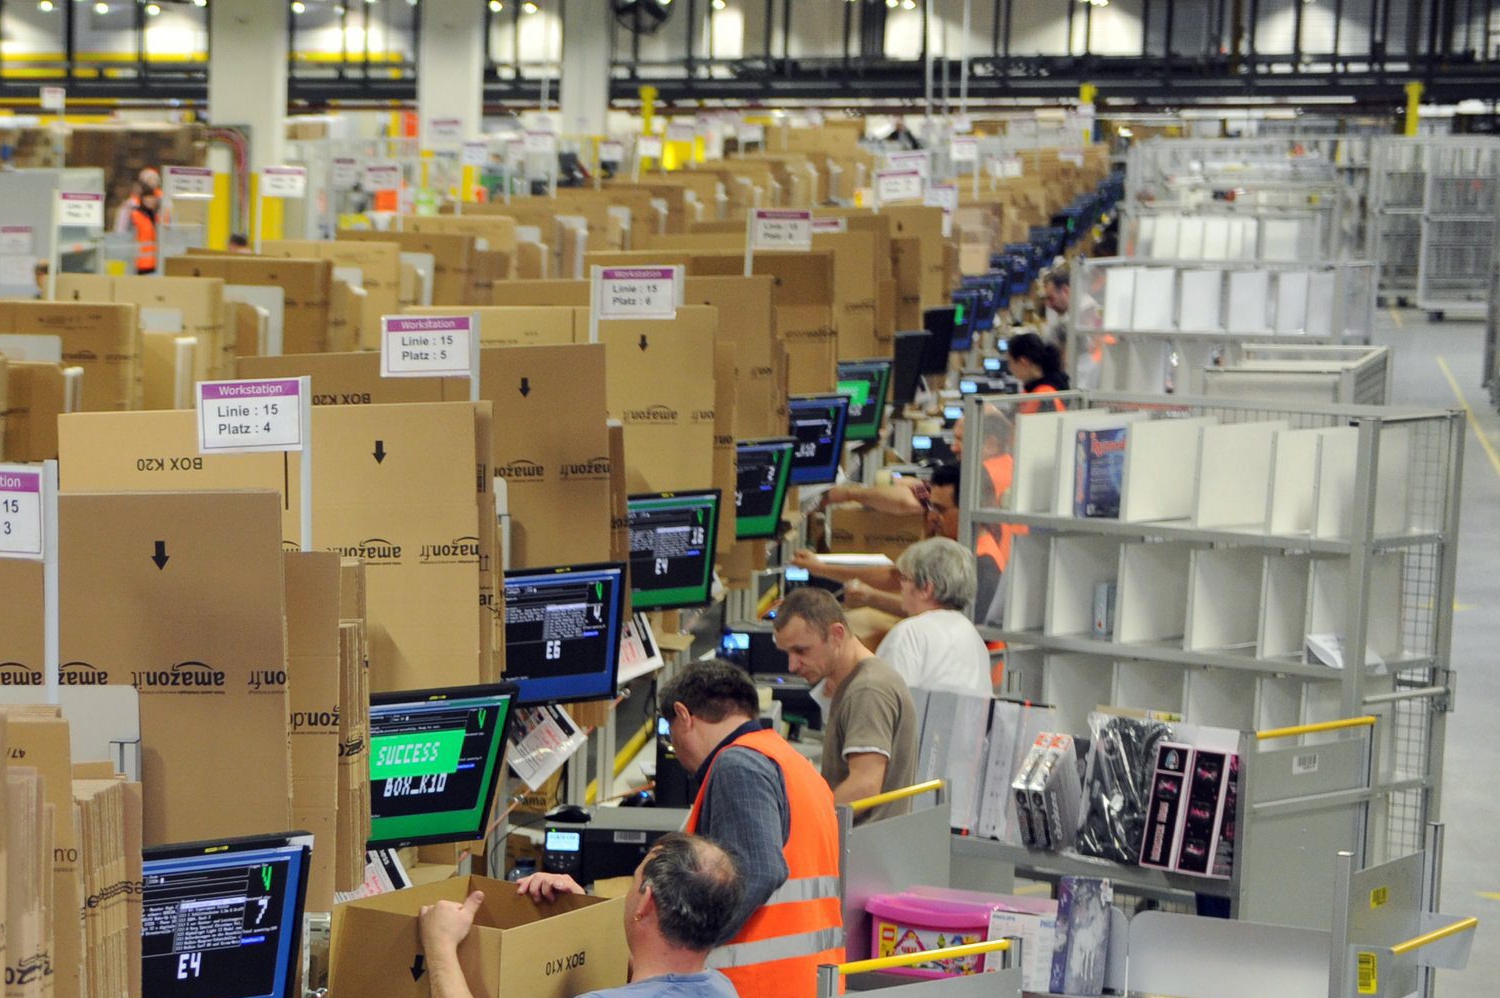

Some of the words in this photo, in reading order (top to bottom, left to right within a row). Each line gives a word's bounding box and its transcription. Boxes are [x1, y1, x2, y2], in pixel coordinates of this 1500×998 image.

[401, 319, 456, 331] Workstation
[401, 335, 430, 347] Linie
[440, 335, 454, 346] 15
[402, 351, 430, 361] Platz
[440, 350, 448, 361] 5
[219, 383, 283, 397] Workstation
[217, 405, 250, 419] Linie
[263, 403, 279, 416] 15
[218, 422, 252, 436] Platz
[263, 421, 272, 433] 4
[136, 457, 166, 472] K20
[169, 457, 204, 472] BOX
[2, 499, 20, 514] 15
[4, 521, 13, 535] 3
[546, 640, 561, 660] E6
[131, 670, 226, 691] amazon.it
[376, 741, 441, 767] SUCCESS
[177, 951, 202, 980] E4
[545, 960, 564, 977] K10
[566, 951, 586, 971] BOX
